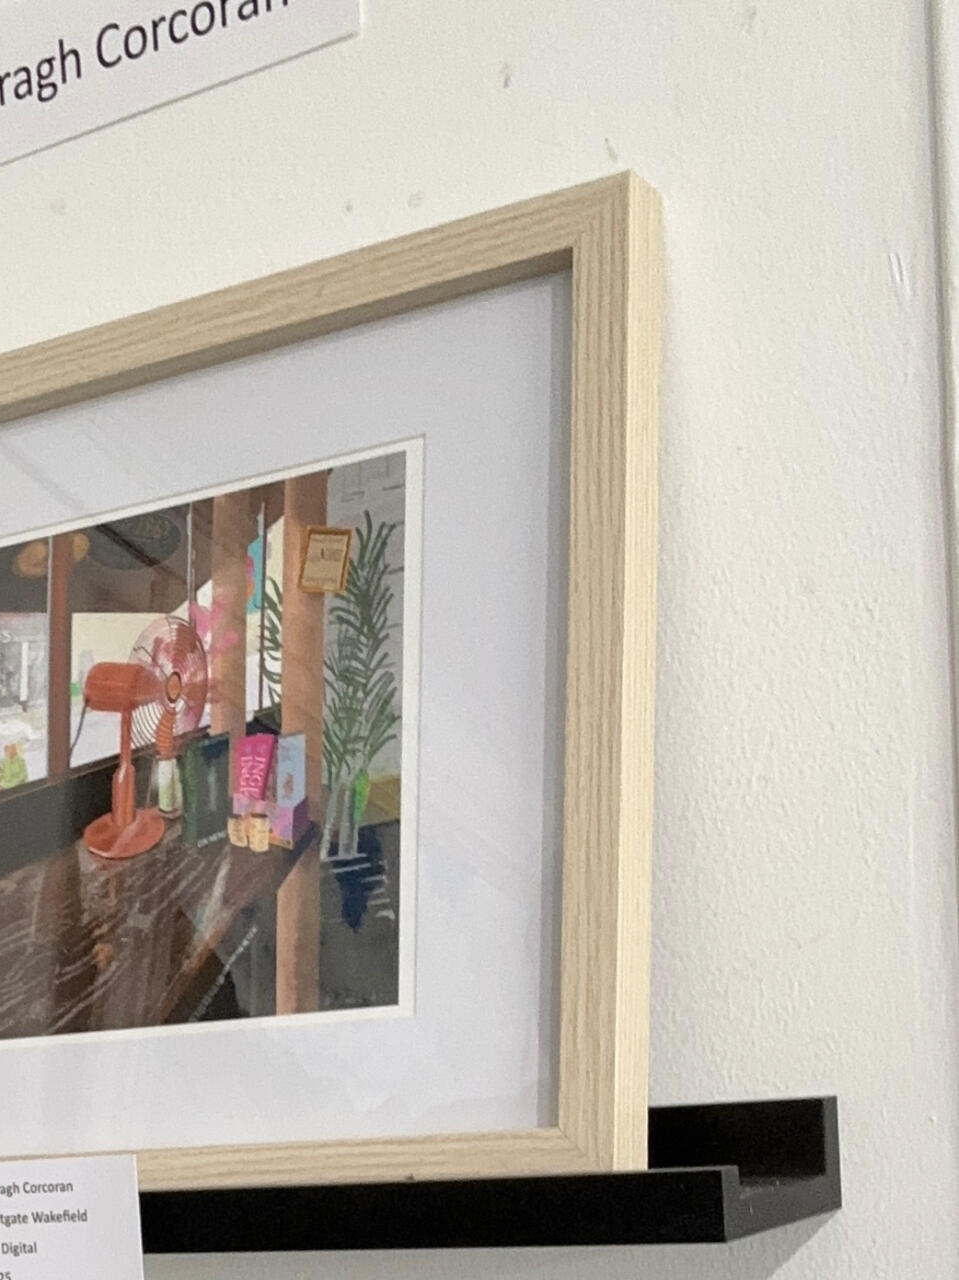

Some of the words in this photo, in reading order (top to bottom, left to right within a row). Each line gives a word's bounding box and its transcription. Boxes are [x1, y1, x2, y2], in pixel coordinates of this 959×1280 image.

[96, 0, 289, 69] Corcora
[22, 1181, 74, 1195] Corcoran
[31, 1208, 88, 1224] Wakefield
[1, 1241, 38, 1257] Digital
